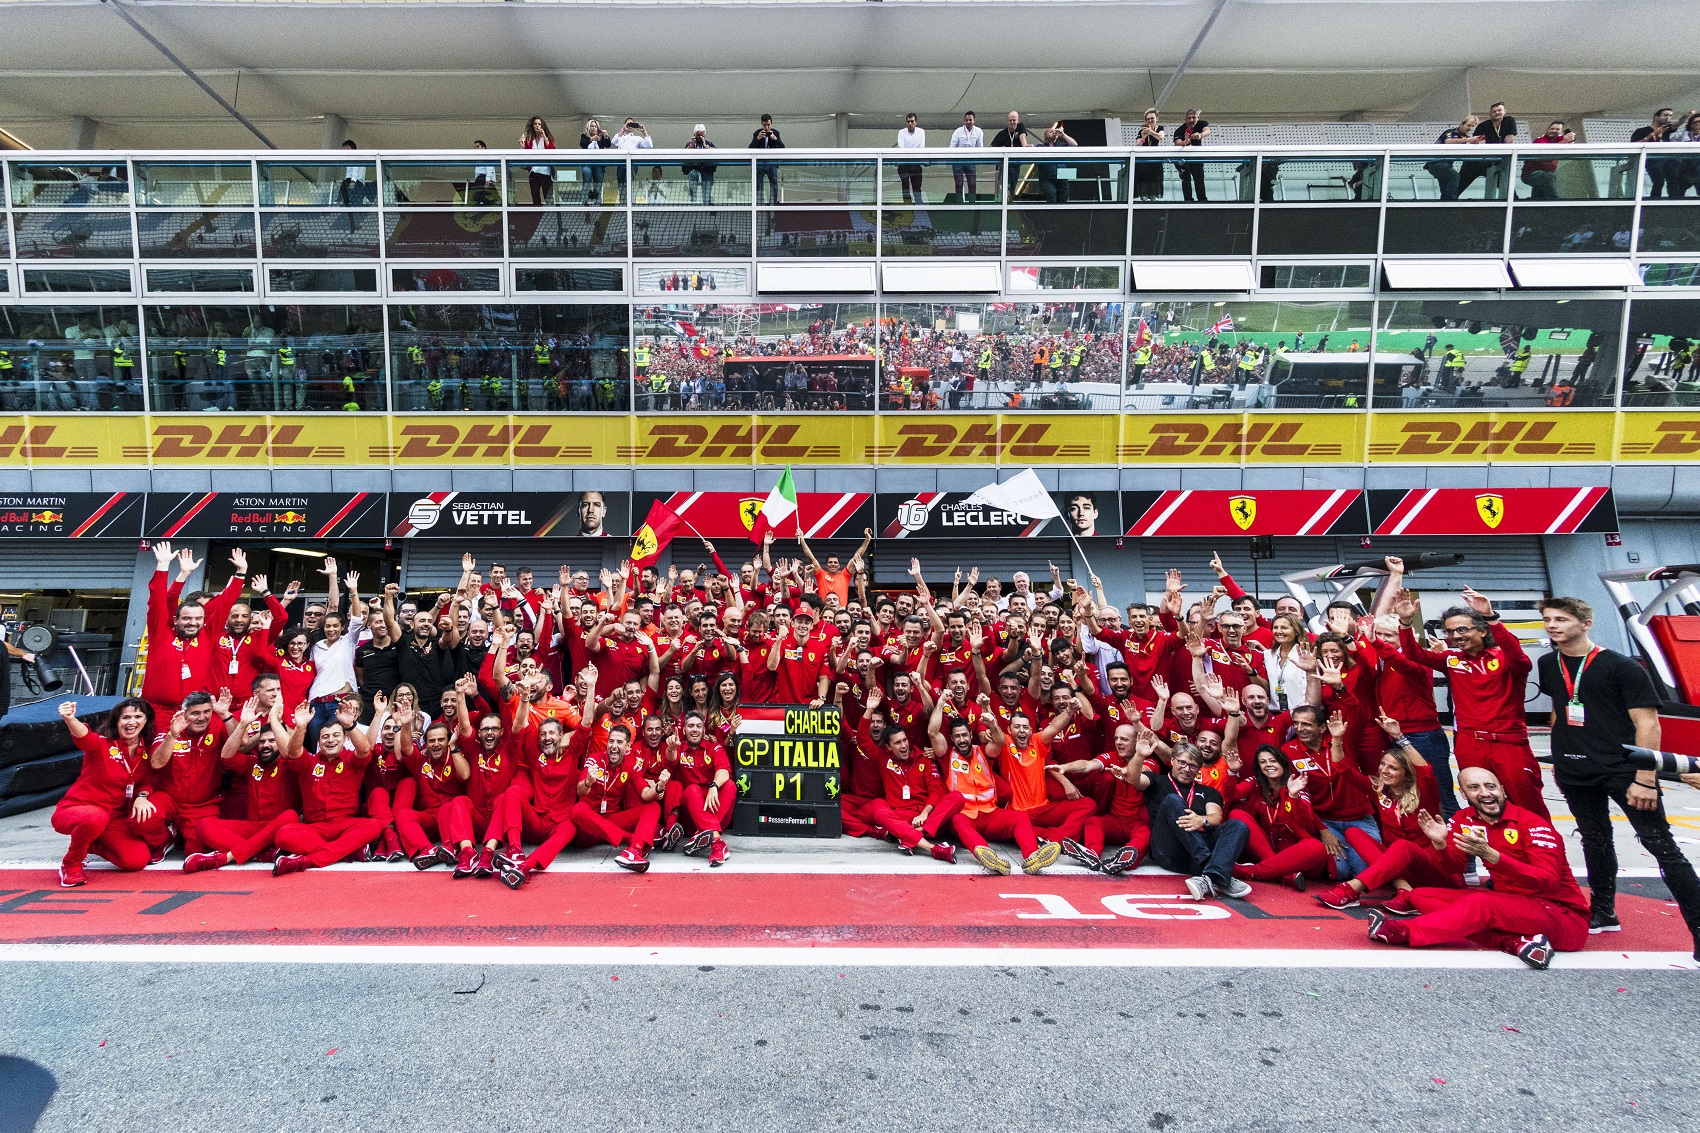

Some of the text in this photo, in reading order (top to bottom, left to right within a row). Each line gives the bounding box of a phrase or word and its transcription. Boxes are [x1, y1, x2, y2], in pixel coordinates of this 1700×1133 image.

[151, 425, 315, 458] DHL
[398, 424, 562, 458] DHL
[645, 424, 813, 458] DHL
[894, 424, 1059, 457] DHL
[1145, 422, 1311, 456] DHL
[1395, 421, 1566, 455] DHL
[27, 497, 66, 506] MARTIN
[232, 497, 309, 506] ASTON MARTIN
[452, 502, 504, 510] SEBASTIAN
[941, 503, 983, 511] CHARLES
[452, 510, 532, 525] VETTEL
[897, 503, 928, 526] 16
[942, 511, 1030, 527] LECLERC
[230, 525, 306, 533] RACING
[1605, 534, 1621, 543] 13
[141, 540, 151, 548] 19
[1116, 538, 1123, 546] 15
[1360, 537, 1371, 545] 14
[785, 709, 841, 735] CHARLES
[736, 738, 841, 768] GP ITALIA
[0, 889, 254, 915] ET
[998, 893, 1232, 920] 16
